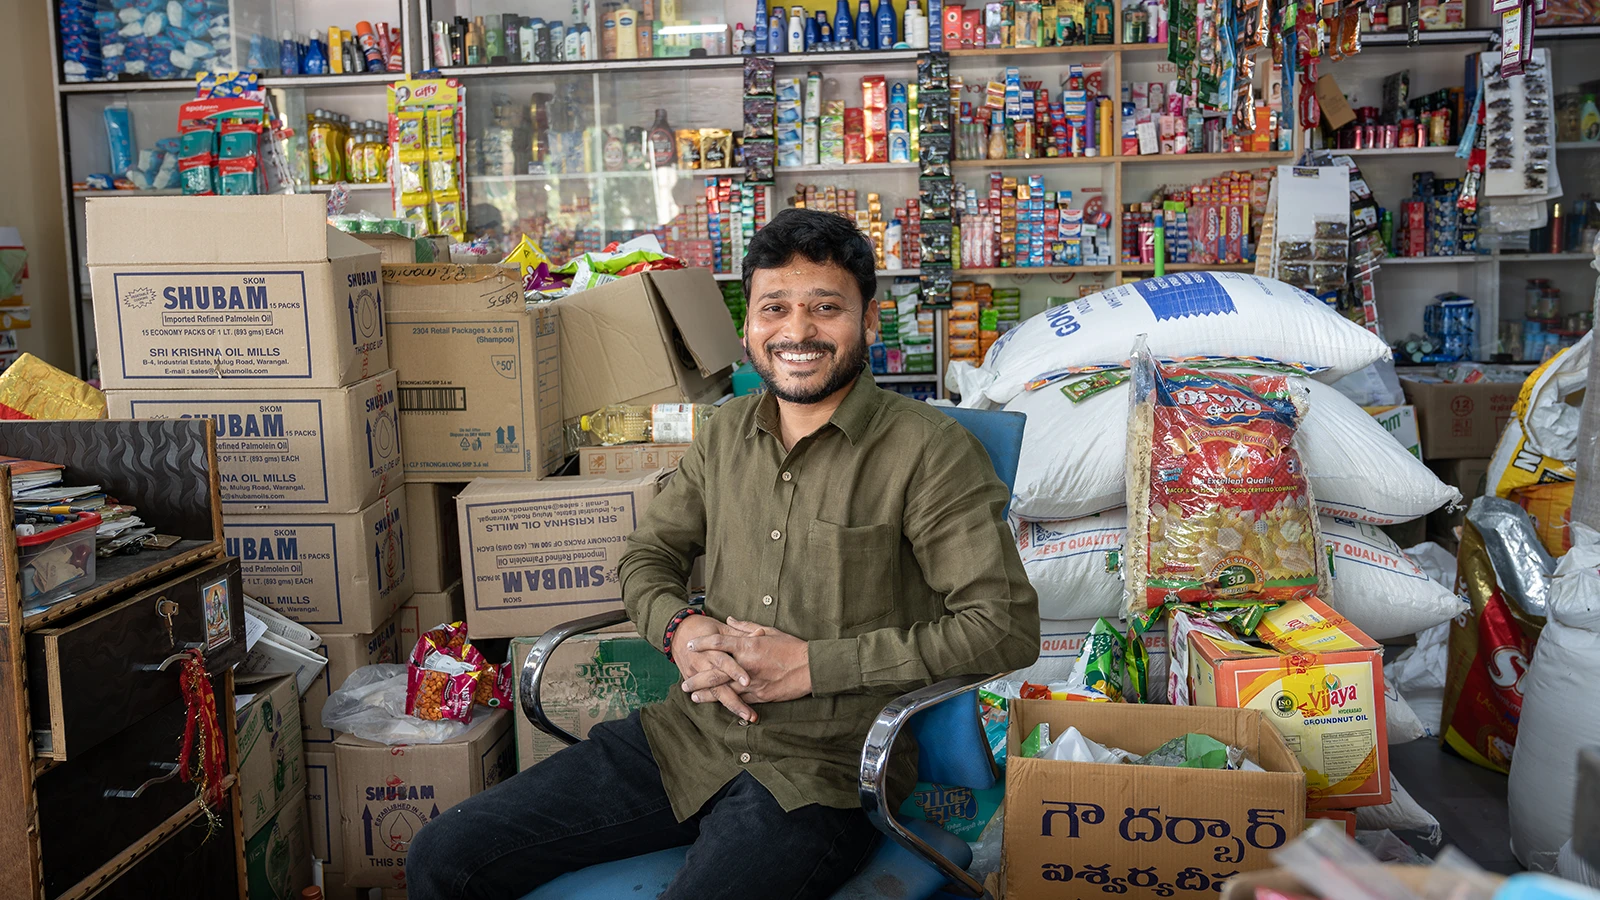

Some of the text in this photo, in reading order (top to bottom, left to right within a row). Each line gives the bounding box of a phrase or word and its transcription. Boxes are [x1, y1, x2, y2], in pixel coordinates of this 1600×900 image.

[414, 85, 437, 98] Giffy
[242, 277, 266, 285] SKOM
[348, 270, 378, 288] SHUBAM
[163, 286, 268, 310] SHUBAM
[277, 302, 300, 310] PACKS
[164, 314, 271, 324] Imported Refined Palmolein Oil
[184, 328, 205, 336] PACKS
[234, 328, 248, 337] (893
[249, 328, 264, 337] gms)
[452, 327, 485, 335] Packages
[476, 335, 515, 344] (Shampoo)
[149, 348, 280, 357] SRI KRISHNA OIL MILLS
[214, 359, 234, 367] Mulug
[256, 359, 289, 367] Warangal.
[1455, 400, 1470, 409] 12
[241, 442, 276, 450] Palmolein
[277, 442, 288, 450] Oil
[249, 455, 263, 463] (893
[264, 455, 280, 463] gms)
[371, 467, 384, 478] THIS
[241, 474, 260, 483] OIL
[263, 474, 297, 482] MILLS
[1246, 477, 1274, 485] Quality
[578, 507, 610, 516] Industrial
[1318, 506, 1394, 524] BEST QUALI
[485, 514, 618, 533] SRI KRISHNA OIL MILLS
[274, 529, 297, 537] SKOM
[564, 537, 586, 546] PACKS
[587, 535, 621, 544] ECONOMY
[1068, 533, 1121, 549] QUALITY
[226, 537, 298, 560] UBAM
[476, 545, 495, 553] EACH
[498, 550, 605, 566] Imported Refined Palmolein Oil
[1343, 543, 1399, 568] QUALITY
[255, 565, 290, 573] Palmolein
[290, 565, 301, 573] Oil
[1233, 557, 1253, 567] SALE
[1253, 564, 1264, 583] PACK
[263, 578, 277, 586] (893
[278, 578, 294, 586] gms)
[501, 565, 605, 593] SHUBAM
[1227, 574, 1246, 586] 3D
[1221, 585, 1250, 595] Papad
[255, 596, 311, 605] OIL MILLS
[1042, 638, 1087, 651] QUALI
[1145, 636, 1168, 648] BES
[1307, 684, 1357, 712] Vijaya
[1338, 707, 1362, 715] HYDERABAD
[1303, 714, 1368, 726] GROUNDNUT OIL
[365, 784, 435, 801] SHUBAM
[373, 802, 411, 827] ESTABLISHED
[369, 857, 407, 867] THIS SI
